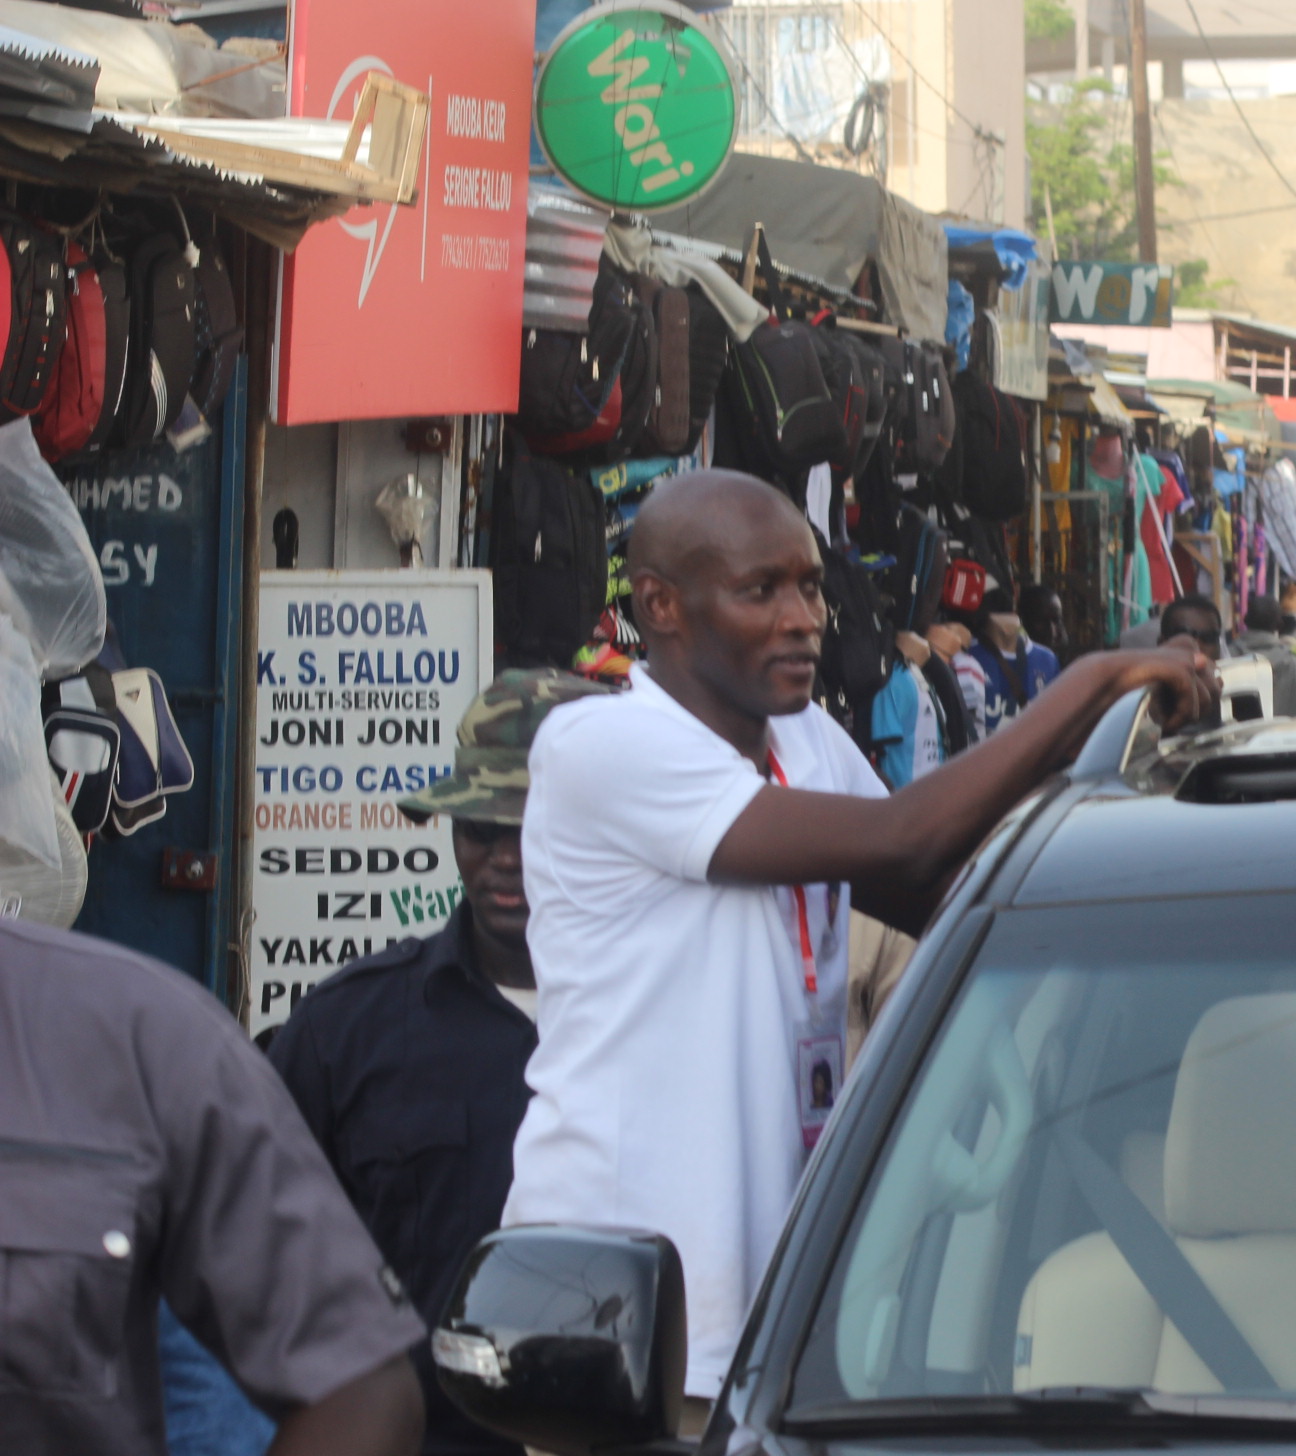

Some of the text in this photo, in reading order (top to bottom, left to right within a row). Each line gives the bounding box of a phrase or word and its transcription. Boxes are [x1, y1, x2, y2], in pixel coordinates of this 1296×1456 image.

[447, 94, 506, 143] MBOOBA KEUR
[587, 28, 694, 192] Wari
[443, 164, 512, 211] SERIGNE FALLOU
[64, 474, 183, 511] HMED
[287, 601, 428, 637] MBOOBA
[257, 650, 460, 687] K. S. FALLOU
[272, 690, 440, 712] MULTI-SERVICES
[260, 718, 440, 747] JONI JONI
[256, 765, 451, 793] TIGO CASH
[255, 802, 440, 830] ORANGE MON
[259, 847, 439, 875] SEDDO
[317, 891, 382, 921] IZI
